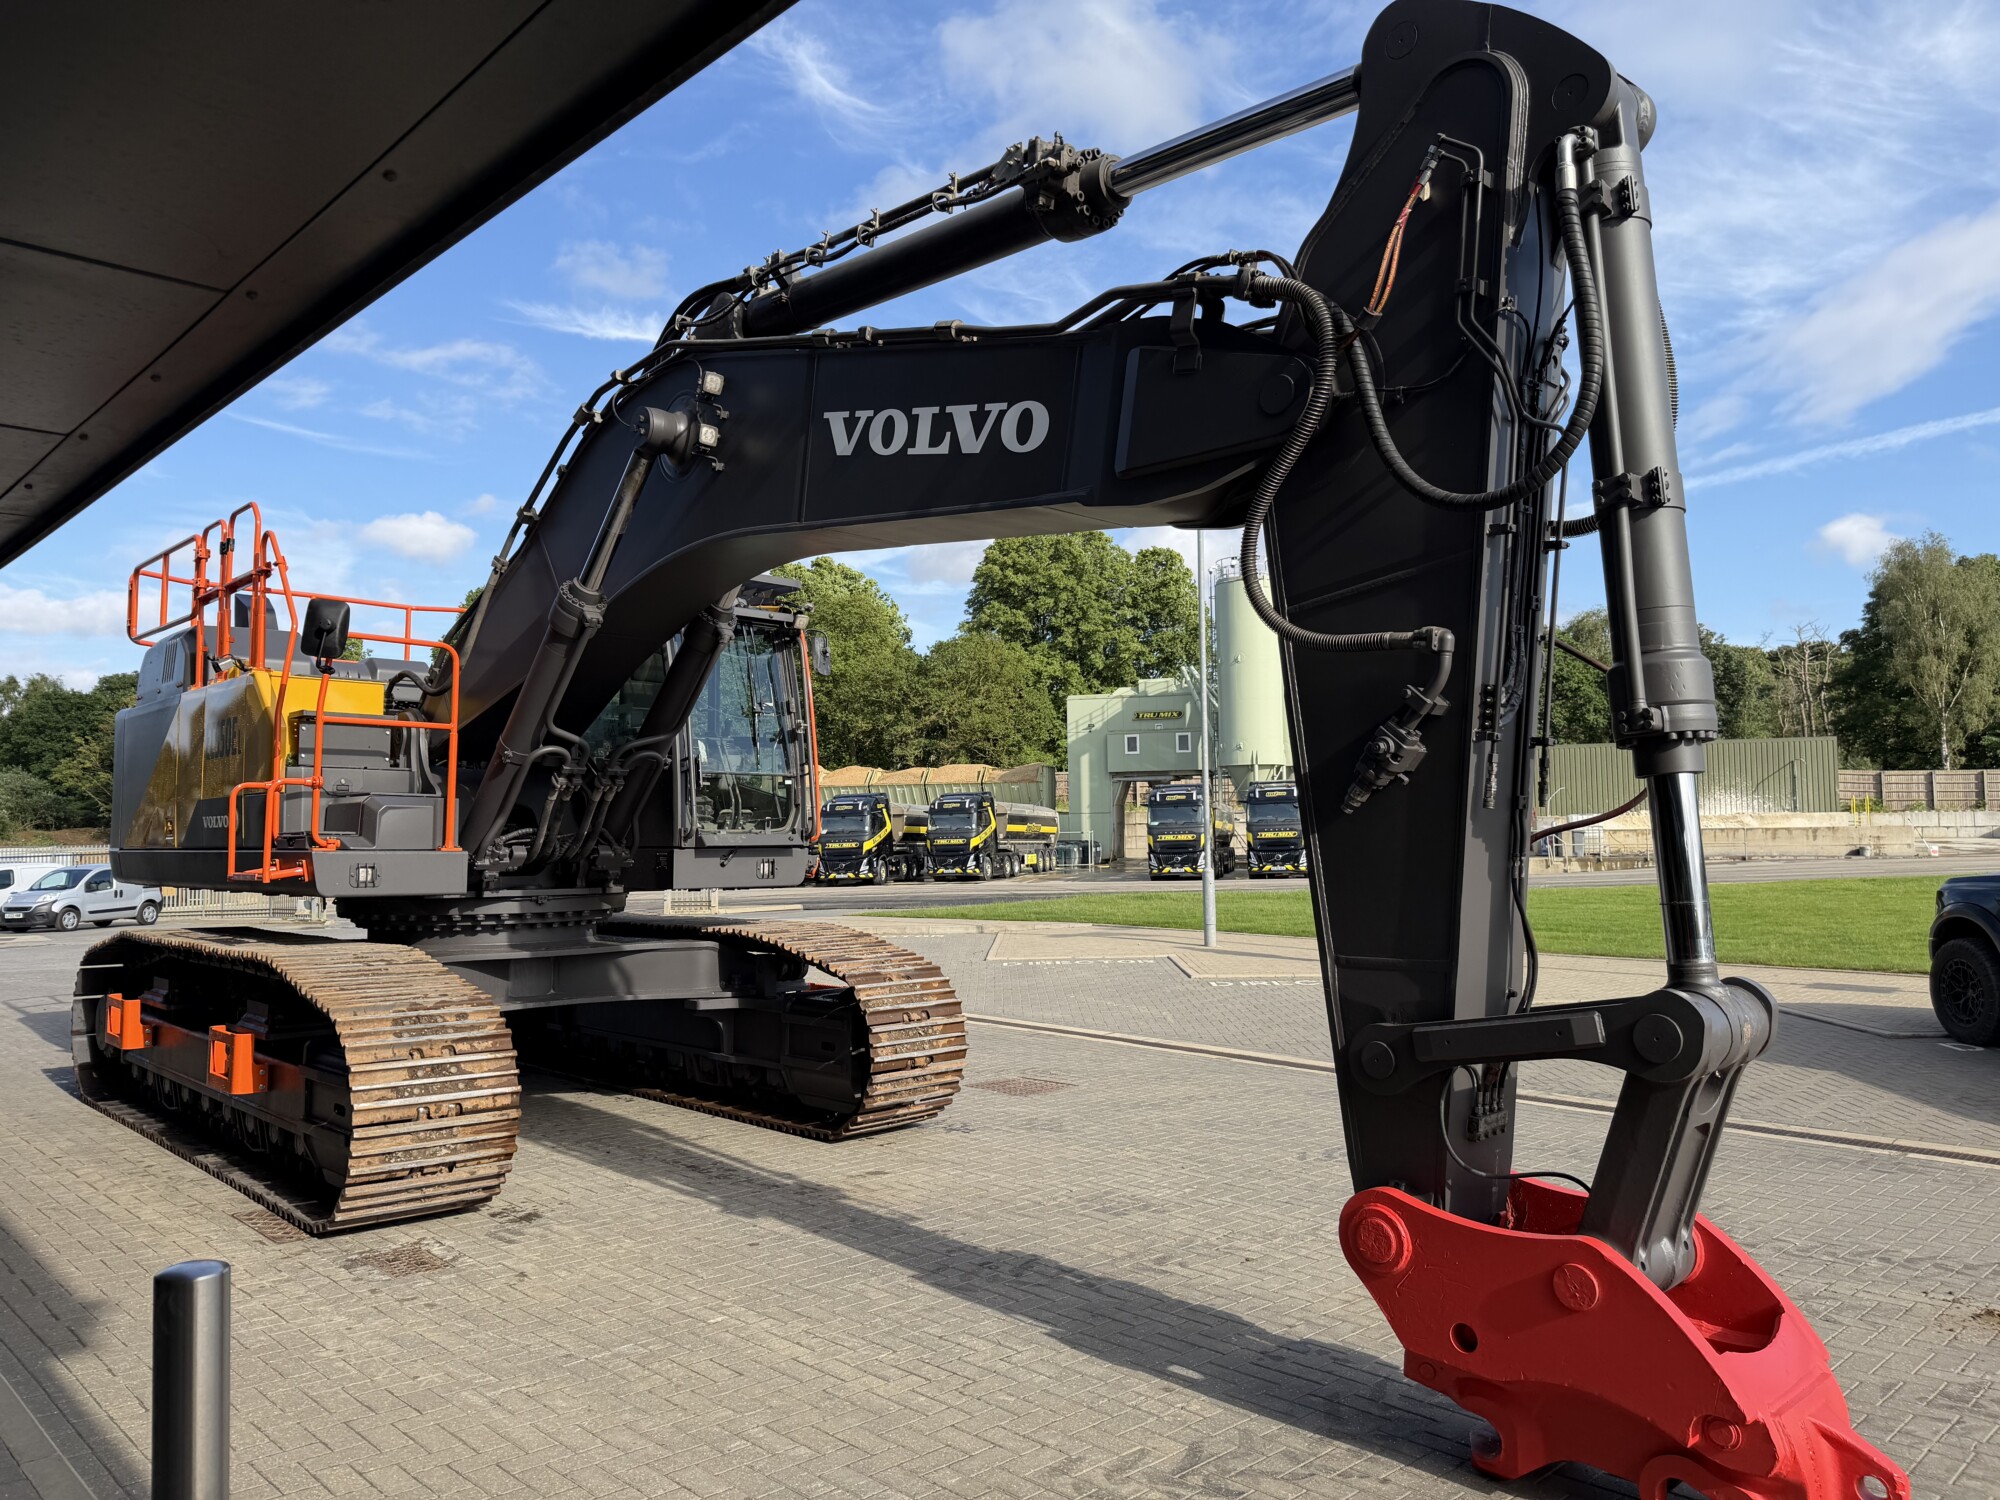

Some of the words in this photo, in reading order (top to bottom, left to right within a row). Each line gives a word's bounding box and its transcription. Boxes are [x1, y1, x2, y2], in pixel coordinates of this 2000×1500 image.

[822, 400, 1050, 456] VOLVO
[202, 815, 230, 829] VOLVO
[1208, 979, 1323, 987] DIREC
